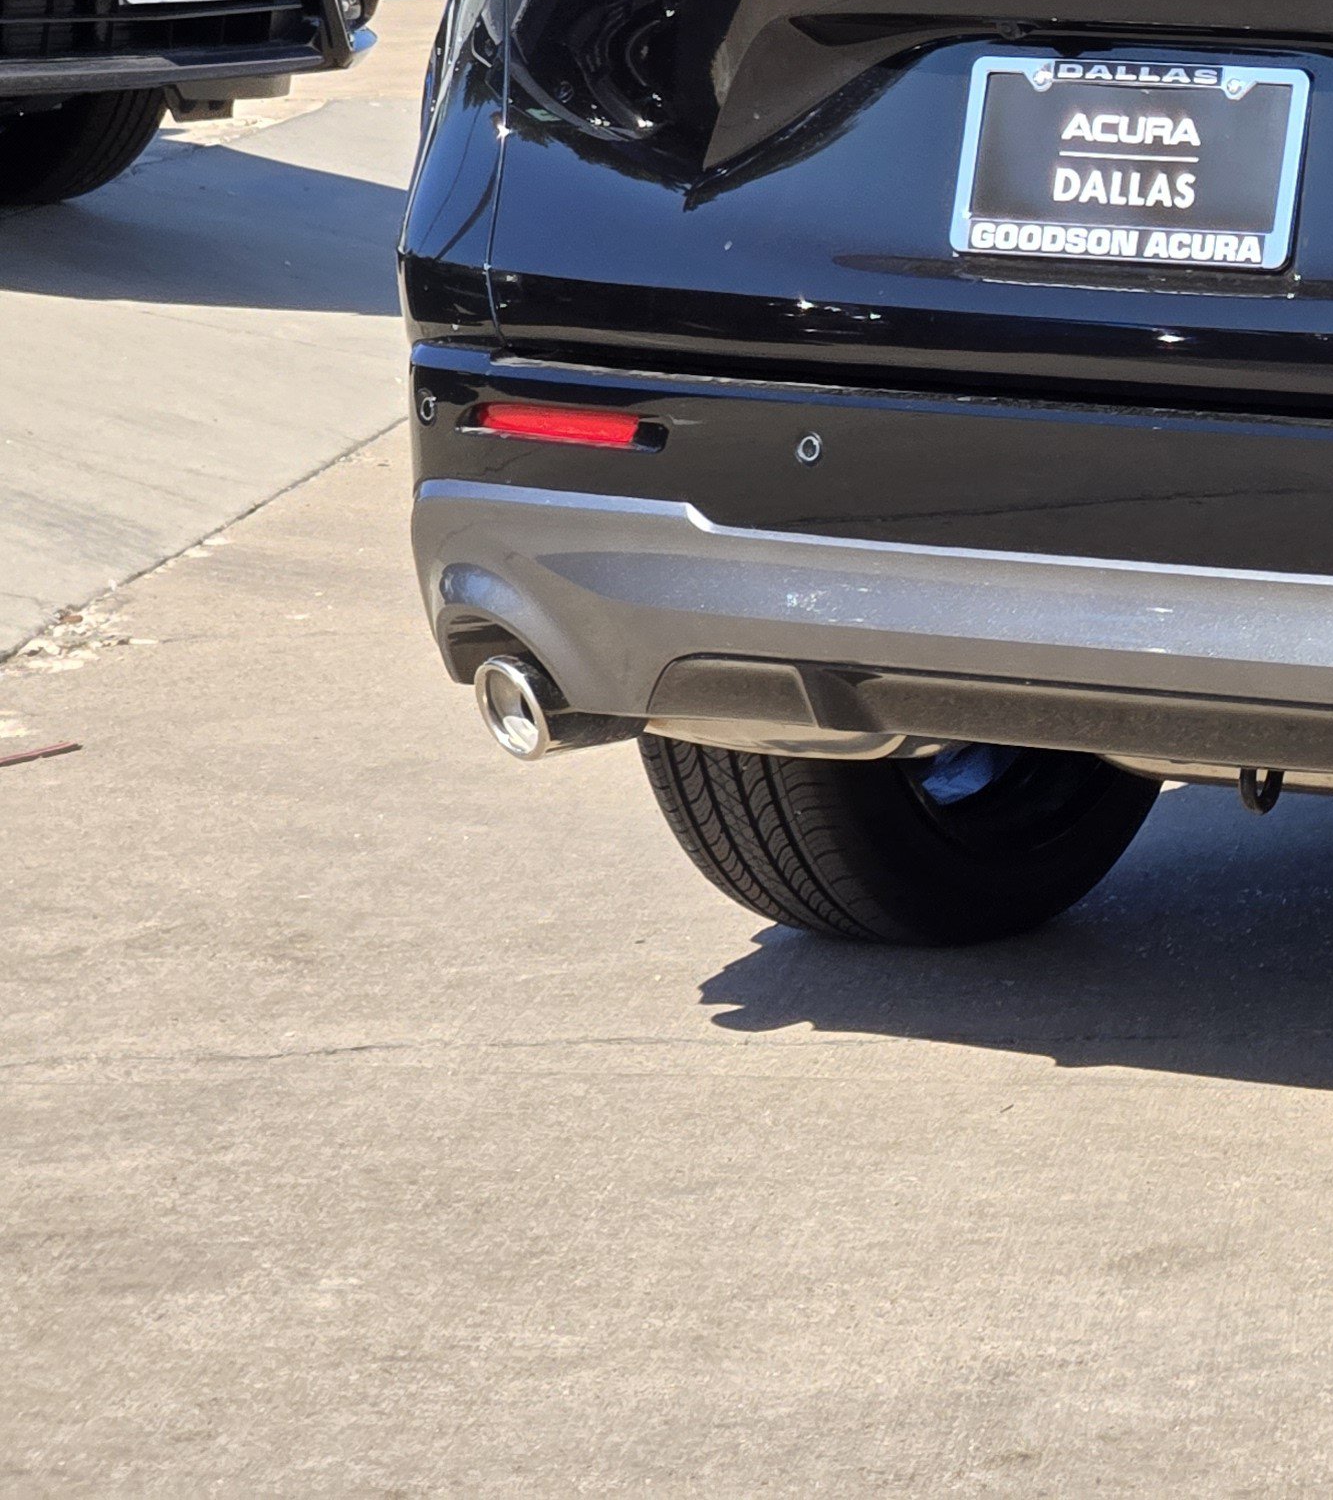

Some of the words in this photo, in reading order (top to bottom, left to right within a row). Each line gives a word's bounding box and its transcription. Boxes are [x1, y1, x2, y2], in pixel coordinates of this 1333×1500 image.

[1057, 63, 1218, 85] DALLAS
[1061, 113, 1201, 146] ACURA
[1053, 167, 1196, 209] DALLAS
[971, 222, 1139, 257] GOODSON
[1143, 231, 1262, 263] ACURA
